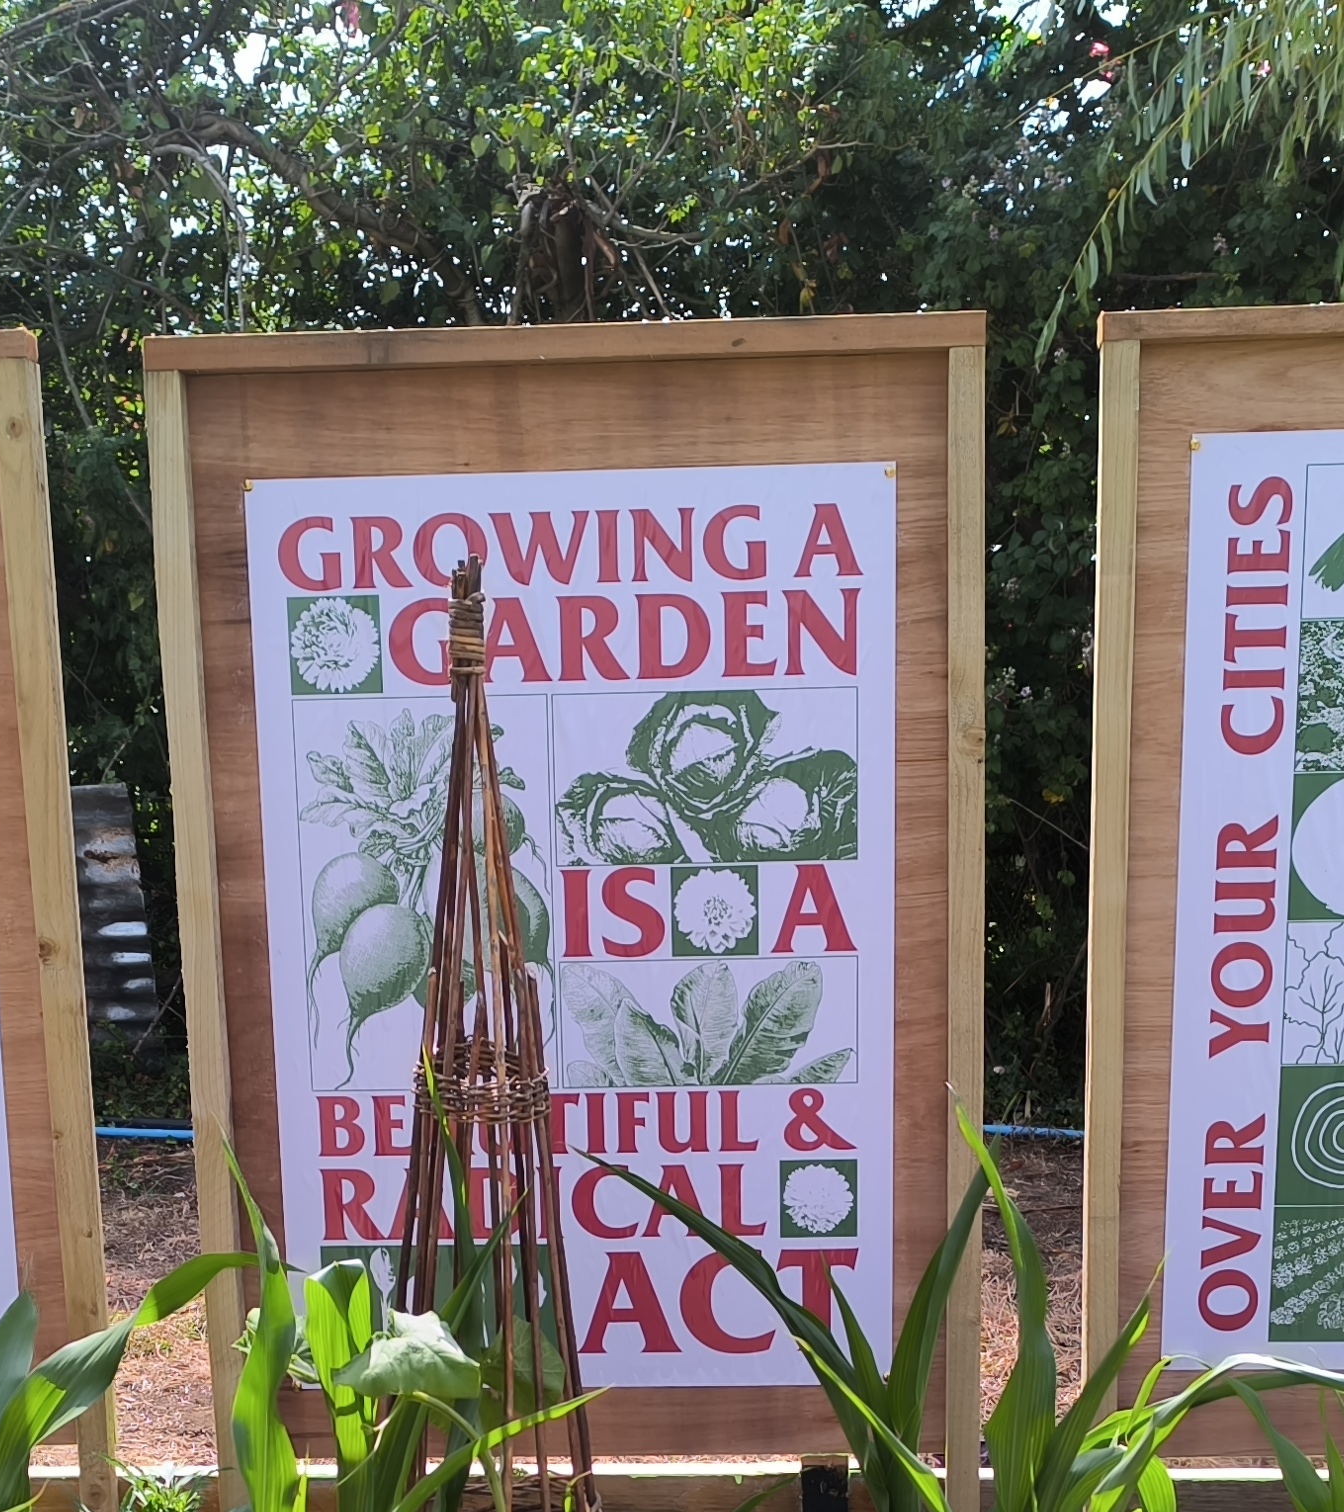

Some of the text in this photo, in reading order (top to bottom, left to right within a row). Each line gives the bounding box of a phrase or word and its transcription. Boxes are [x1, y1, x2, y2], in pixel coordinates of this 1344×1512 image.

[276, 503, 864, 593] GROWING A
[388, 587, 861, 687] GARDEN
[560, 864, 858, 958] IS A
[1197, 475, 1294, 1333] OVER YOUR CITIES
[783, 1087, 857, 1150] &
[579, 1247, 859, 1354] ACT
